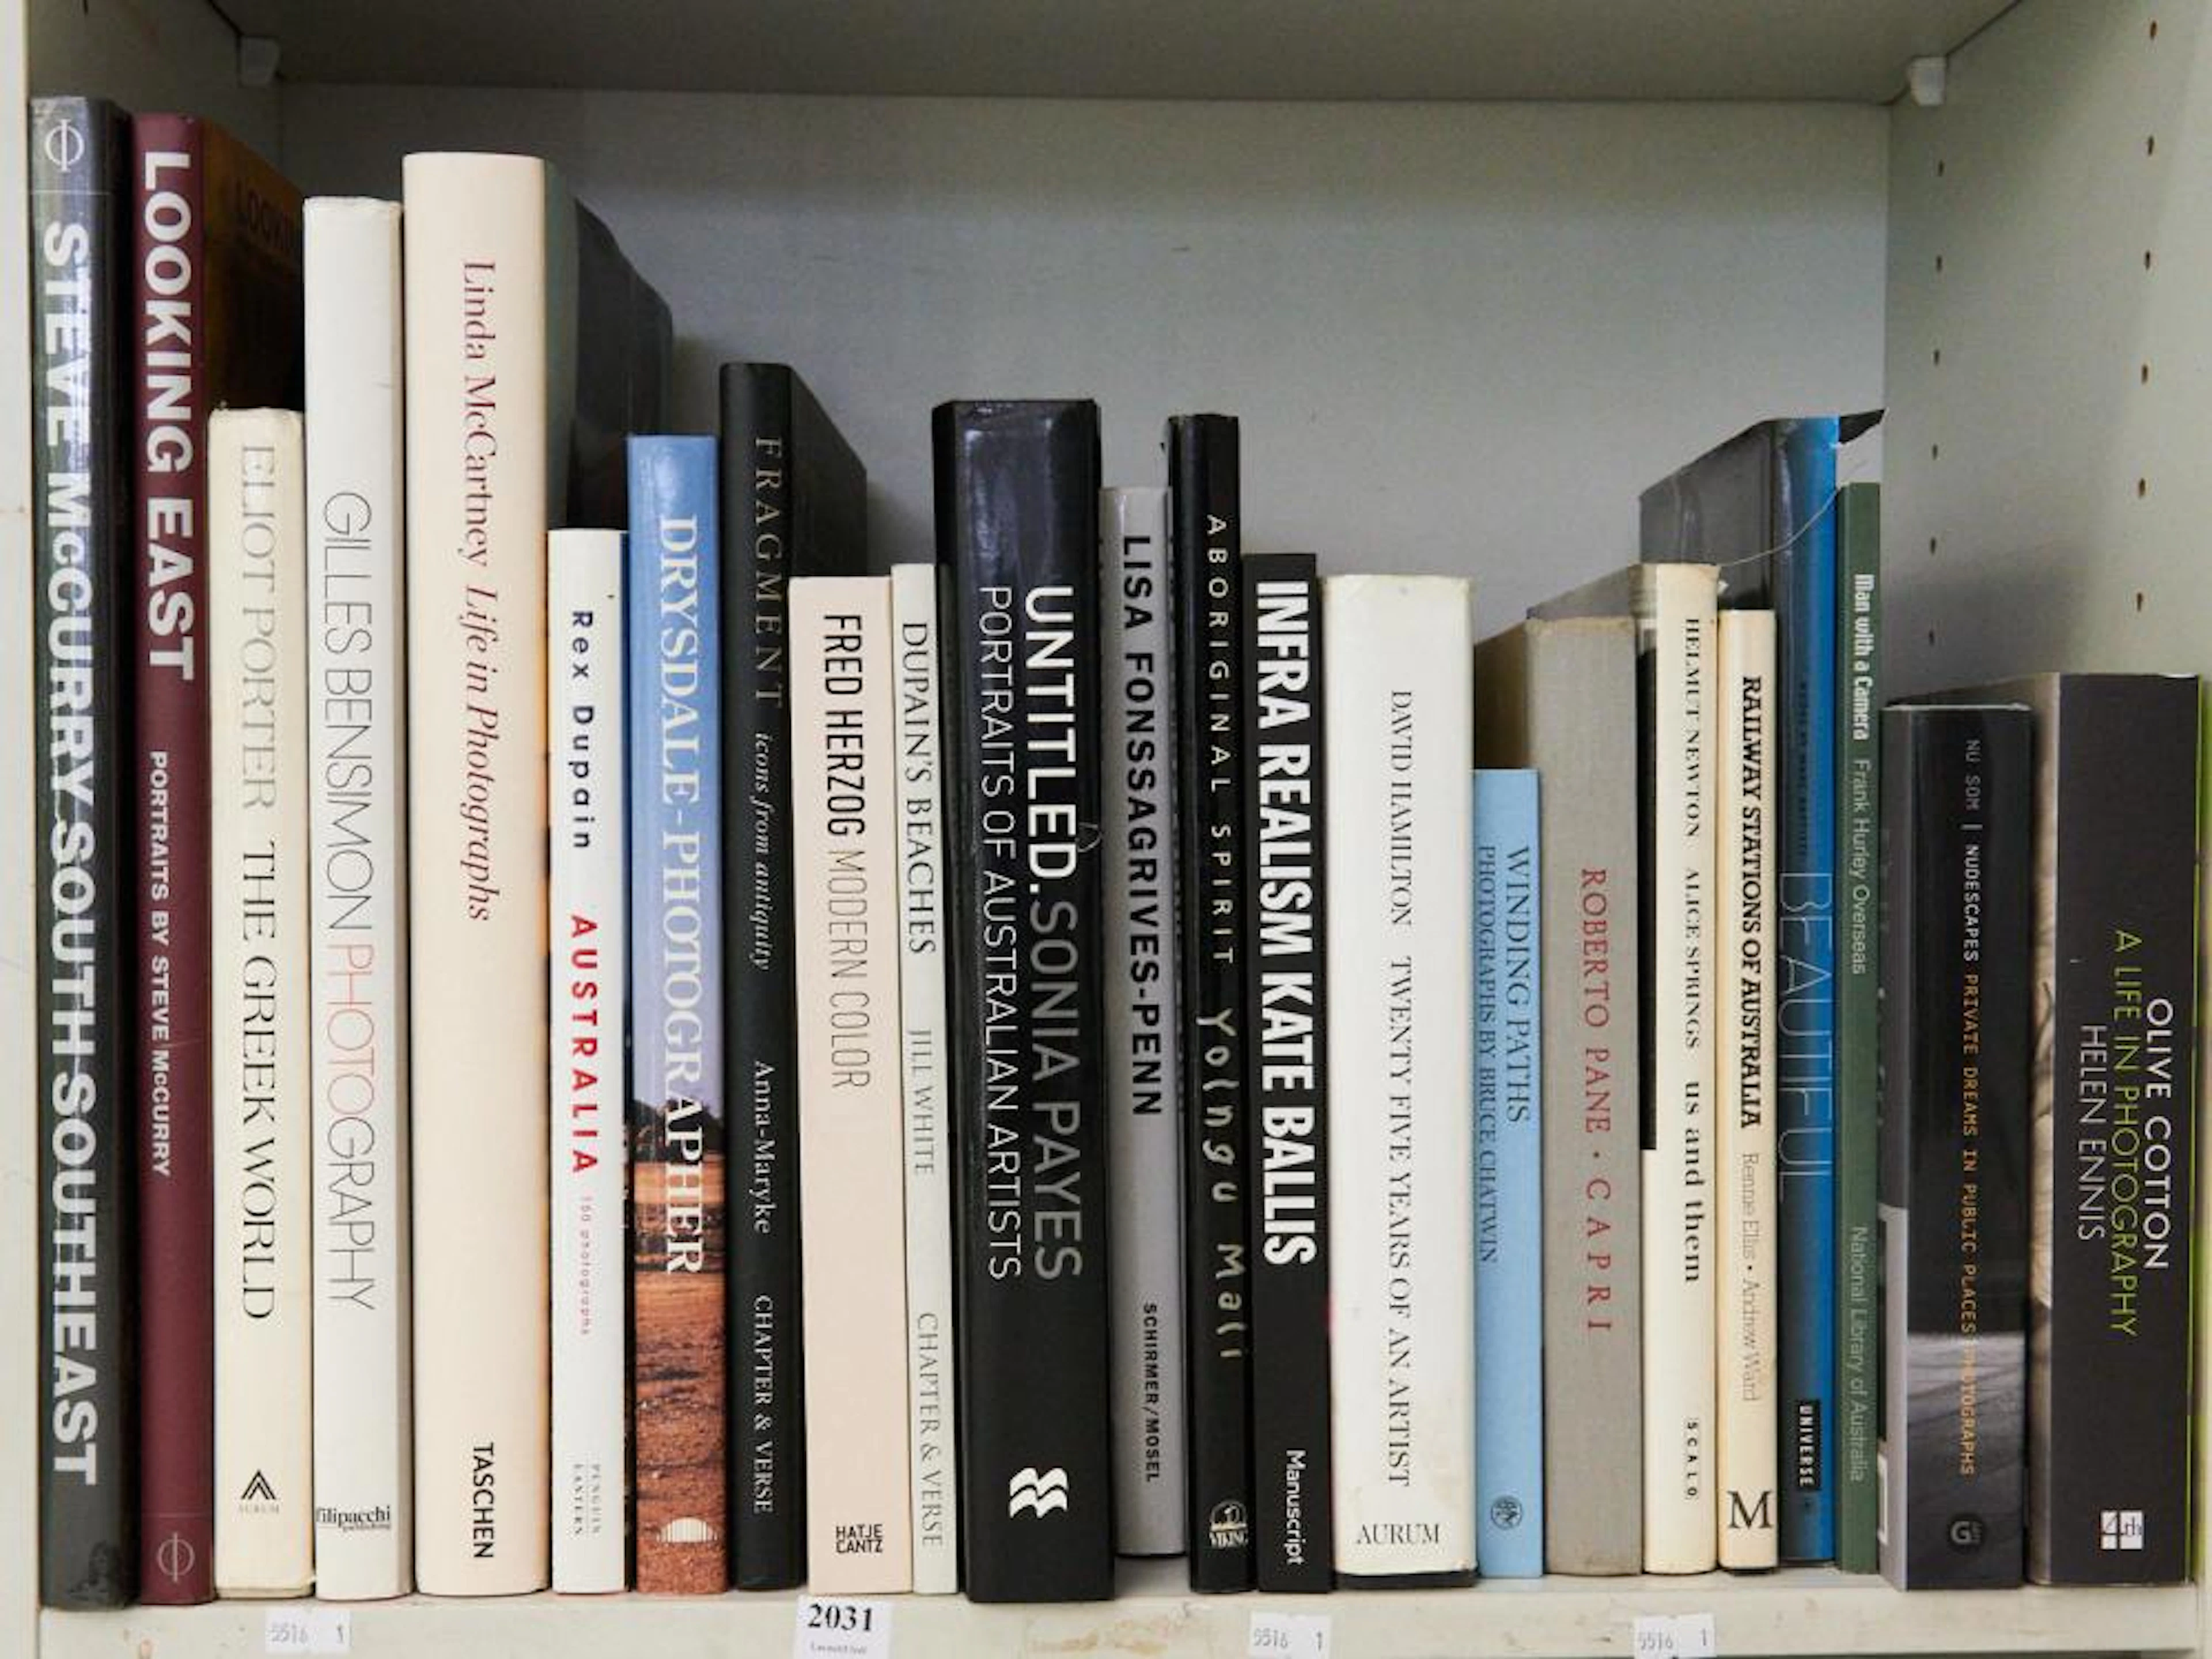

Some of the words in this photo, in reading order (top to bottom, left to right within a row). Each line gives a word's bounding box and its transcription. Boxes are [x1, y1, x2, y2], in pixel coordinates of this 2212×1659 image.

[43, 223, 92, 447] STEVE
[145, 151, 192, 472] LOOKING
[465, 259, 495, 358] Linda
[243, 446, 275, 592] ELIOT
[459, 377, 495, 566] McCartney
[147, 498, 193, 680] EAST
[324, 493, 372, 654] GILLES
[460, 584, 498, 652] Life
[755, 438, 783, 707] FRAGMENT
[1124, 536, 1152, 629] LISA
[1855, 575, 1874, 612] Man
[48, 472, 93, 800] McCURRY
[467, 662, 497, 692] in
[573, 612, 593, 677] Rex
[824, 616, 862, 694] FRED
[1207, 515, 1230, 791] ABORIGINAL
[1257, 582, 1310, 729] INFRA
[1686, 619, 1699, 722] HELMUT
[1854, 617, 1874, 656] with
[1854, 661, 1869, 671] a
[243, 608, 275, 808] PORTER
[903, 623, 931, 781] DUPAIN'S
[979, 587, 1014, 797] PORTRAITS
[1392, 692, 1411, 771] DAVID
[1743, 677, 1761, 800] RAILWAY
[1854, 676, 1873, 740] Camera
[325, 669, 374, 929] BENSIMON
[460, 705, 499, 920] Photographs
[569, 706, 594, 847] Dupain
[755, 733, 774, 793] icons
[826, 711, 865, 835] HERZOG
[1687, 731, 1699, 836] NEWTON
[1852, 759, 1872, 813] Frank
[151, 752, 169, 900] PORTRAITS
[749, 796, 774, 853] from
[983, 811, 1015, 858] OF
[1259, 745, 1312, 956] REALISM
[1391, 782, 1411, 925] HAMILTON
[1743, 807, 1760, 933] STATIONS
[1849, 818, 1872, 878] Hurley
[244, 842, 274, 940] THE
[749, 862, 776, 969] antiquity
[828, 851, 868, 978] MODERN
[907, 799, 935, 953] BEACHES
[1126, 653, 1161, 1114] FONSSAGRIVES-PENN
[1211, 825, 1233, 963] SPIRIT
[1506, 847, 1530, 1005] WINDING
[1687, 867, 1699, 937] ALICE
[1964, 845, 1980, 961] NUDESCAPES
[51, 822, 95, 1054] SOUTH
[152, 911, 169, 946] BY
[1478, 846, 1496, 1023] PHOTOGRAPHS
[1582, 869, 1609, 1027] ROBERTO
[1743, 940, 1760, 974] OF
[1851, 884, 1872, 975] Overseas
[2115, 930, 2142, 952] A
[152, 956, 169, 1040] STEVE
[244, 956, 275, 1123] GREEK
[830, 992, 870, 1088] COLOR
[981, 871, 1018, 1110] AUSTRALIAN
[1262, 973, 1313, 1090] KATE
[1391, 957, 1411, 1083] TWENTY
[1687, 947, 1699, 1047] SPRINGS
[1777, 872, 1834, 1203] BEAUTIFUL
[1964, 975, 1978, 1054] PRIVATE
[2114, 967, 2142, 1020] LIFE
[572, 916, 598, 1172] AUSTRALIA
[909, 1031, 932, 1081] JILL
[1479, 1030, 1496, 1058] BY
[1507, 1021, 1530, 1122] PATHS
[1586, 1048, 1610, 1132] PANE
[1741, 978, 1760, 1128] AUSTRALIA
[2080, 1026, 2107, 1123] HELEN
[2114, 1037, 2141, 1070] IN
[2146, 999, 2173, 1098] OLIVE
[153, 1050, 170, 1176] McCURRY
[328, 945, 375, 1310] PHOTOGRAPHY
[749, 1061, 775, 1233] Anna-Maryke
[914, 1086, 934, 1176] WHITE
[1390, 1097, 1411, 1160] FIVE
[1479, 1069, 1497, 1143] BRUCE
[1686, 1083, 1699, 1114] us
[1964, 1067, 1978, 1135] DREAMS
[988, 1124, 1021, 1279] ARTISTS
[1033, 1103, 1082, 1279] PAYES
[1263, 1107, 1316, 1264] BALLIS
[1479, 1150, 1497, 1262] CHATWIN
[1686, 1129, 1704, 1185] and
[1963, 1150, 1977, 1171] IN
[2078, 1140, 2107, 1240] ENNIS
[2143, 1116, 2171, 1268] COTTON
[244, 1138, 274, 1318] WORLD
[1389, 1173, 1410, 1268] YEARS
[1586, 1179, 1611, 1330] CAPRI
[1685, 1202, 1704, 1281] them
[1961, 1184, 1977, 1252] PUBLIC
[2111, 1086, 2139, 1335] PHOTOGRAPHY
[52, 1072, 97, 1485] SOUTHEAST
[577, 1230, 593, 1336] photographs
[1390, 1278, 1409, 1319] OF
[1849, 1226, 1868, 1301] National
[1960, 1266, 1976, 1334] PLACES
[755, 1296, 772, 1403] CHAPTER
[918, 1313, 940, 1434] CHAPTER
[1389, 1329, 1410, 1370] AN
[1845, 1309, 1868, 1373] Library
[1849, 1379, 1868, 1396] of
[754, 1414, 771, 1430] &
[1143, 1304, 1159, 1482] SCHIRMER/MOSEL
[1389, 1380, 1409, 1486] ARTIST
[1849, 1400, 1868, 1482] Australia
[755, 1442, 772, 1512] VERSE
[921, 1444, 940, 1461] &
[1687, 1422, 1698, 1496] SCALO
[1799, 1405, 1814, 1487] UNIVERSE
[474, 1443, 494, 1557] TASCHEN
[835, 1524, 883, 1540] HATJE
[835, 1539, 883, 1554] CANTZ
[922, 1470, 942, 1548] VERSE
[1284, 1450, 1306, 1564] Manuscript
[1358, 1524, 1438, 1544] AURUM
[1728, 1491, 1771, 1528] M
[807, 1603, 873, 1632] 2031
